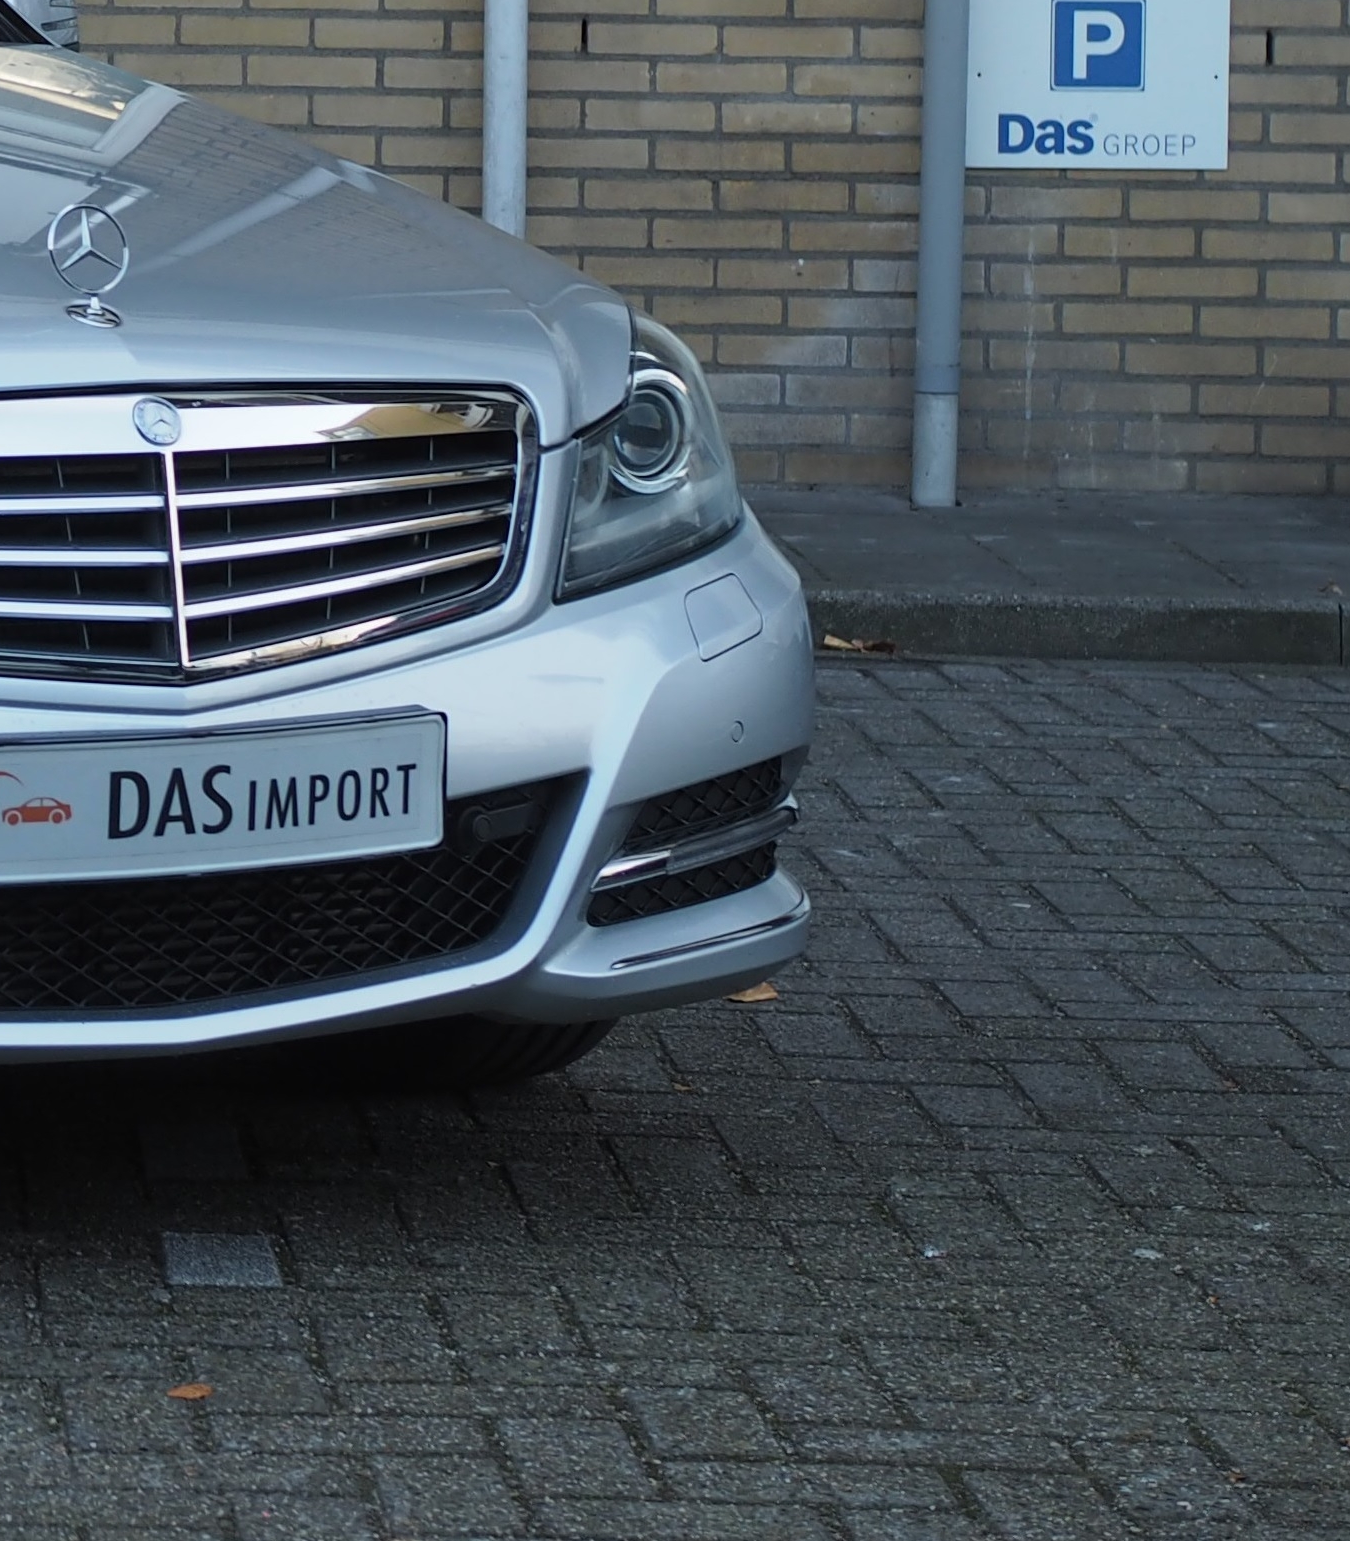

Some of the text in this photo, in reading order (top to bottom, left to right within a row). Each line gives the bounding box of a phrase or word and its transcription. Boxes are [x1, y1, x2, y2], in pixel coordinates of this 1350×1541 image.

[1072, 9, 1126, 80] P
[997, 113, 1197, 157] Das GROEP
[107, 762, 418, 840] DAS IMPORT
